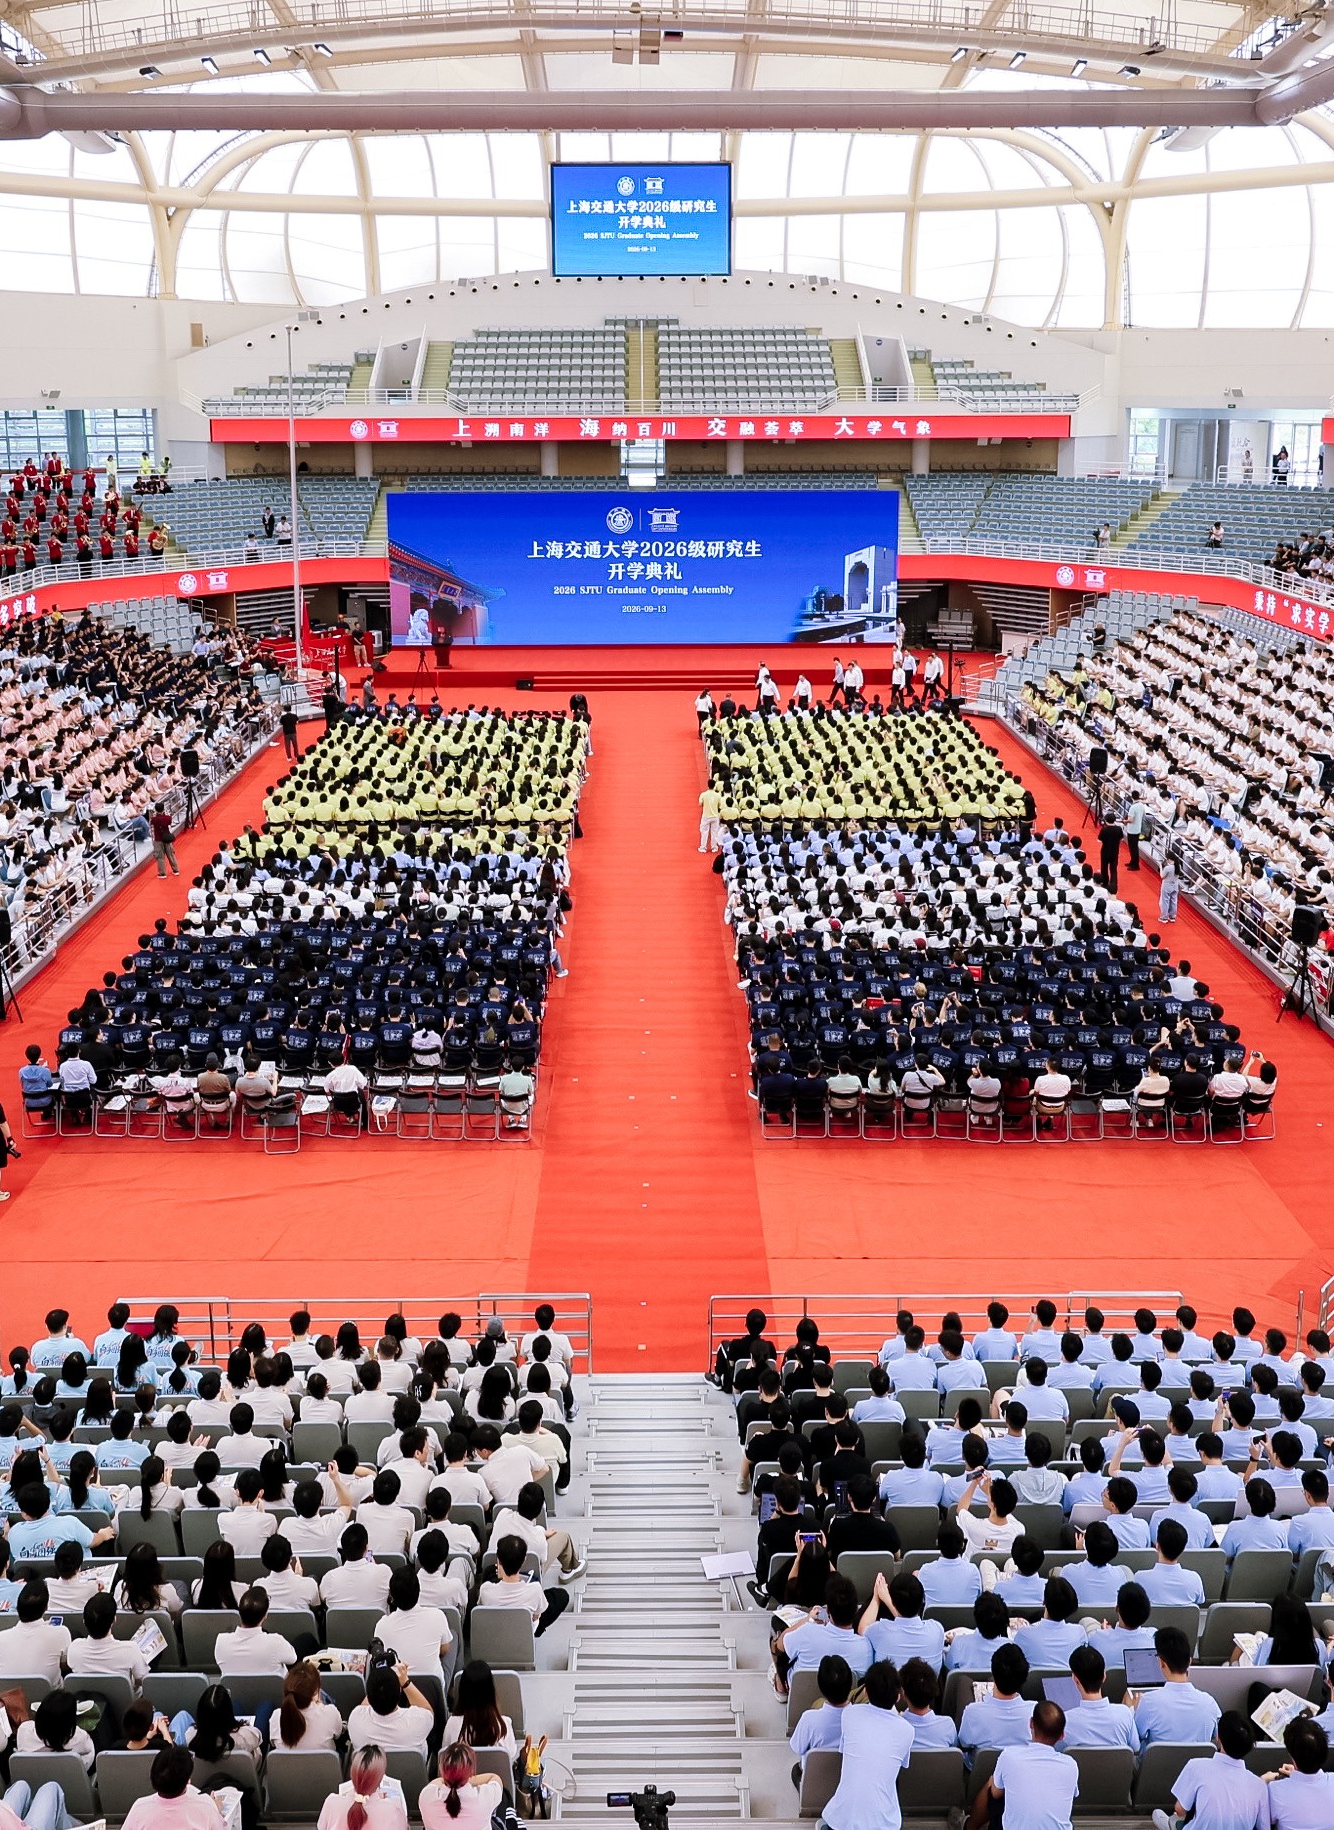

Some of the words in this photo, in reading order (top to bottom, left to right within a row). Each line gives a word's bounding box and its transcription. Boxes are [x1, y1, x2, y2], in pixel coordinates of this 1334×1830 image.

[567, 199, 718, 214] 上海交通大学2026级研究生
[618, 215, 667, 229] 开学典礼
[645, 232, 670, 241] Opening
[672, 232, 699, 240] Assembly
[452, 418, 550, 437] 上溯南洋
[579, 418, 677, 437] 海纳百川
[708, 417, 804, 437] 交融荟萃
[835, 417, 932, 436] 大学气象
[527, 539, 763, 560] 上海交通大学2026级研究生
[607, 561, 683, 582] 开学典礼
[553, 585, 576, 595] 2026
[579, 585, 603, 595] SJTU
[606, 585, 647, 595] Graduate
[650, 585, 688, 597] Opening
[691, 585, 734, 597] Assembly
[621, 604, 667, 613] 2026-09-13
